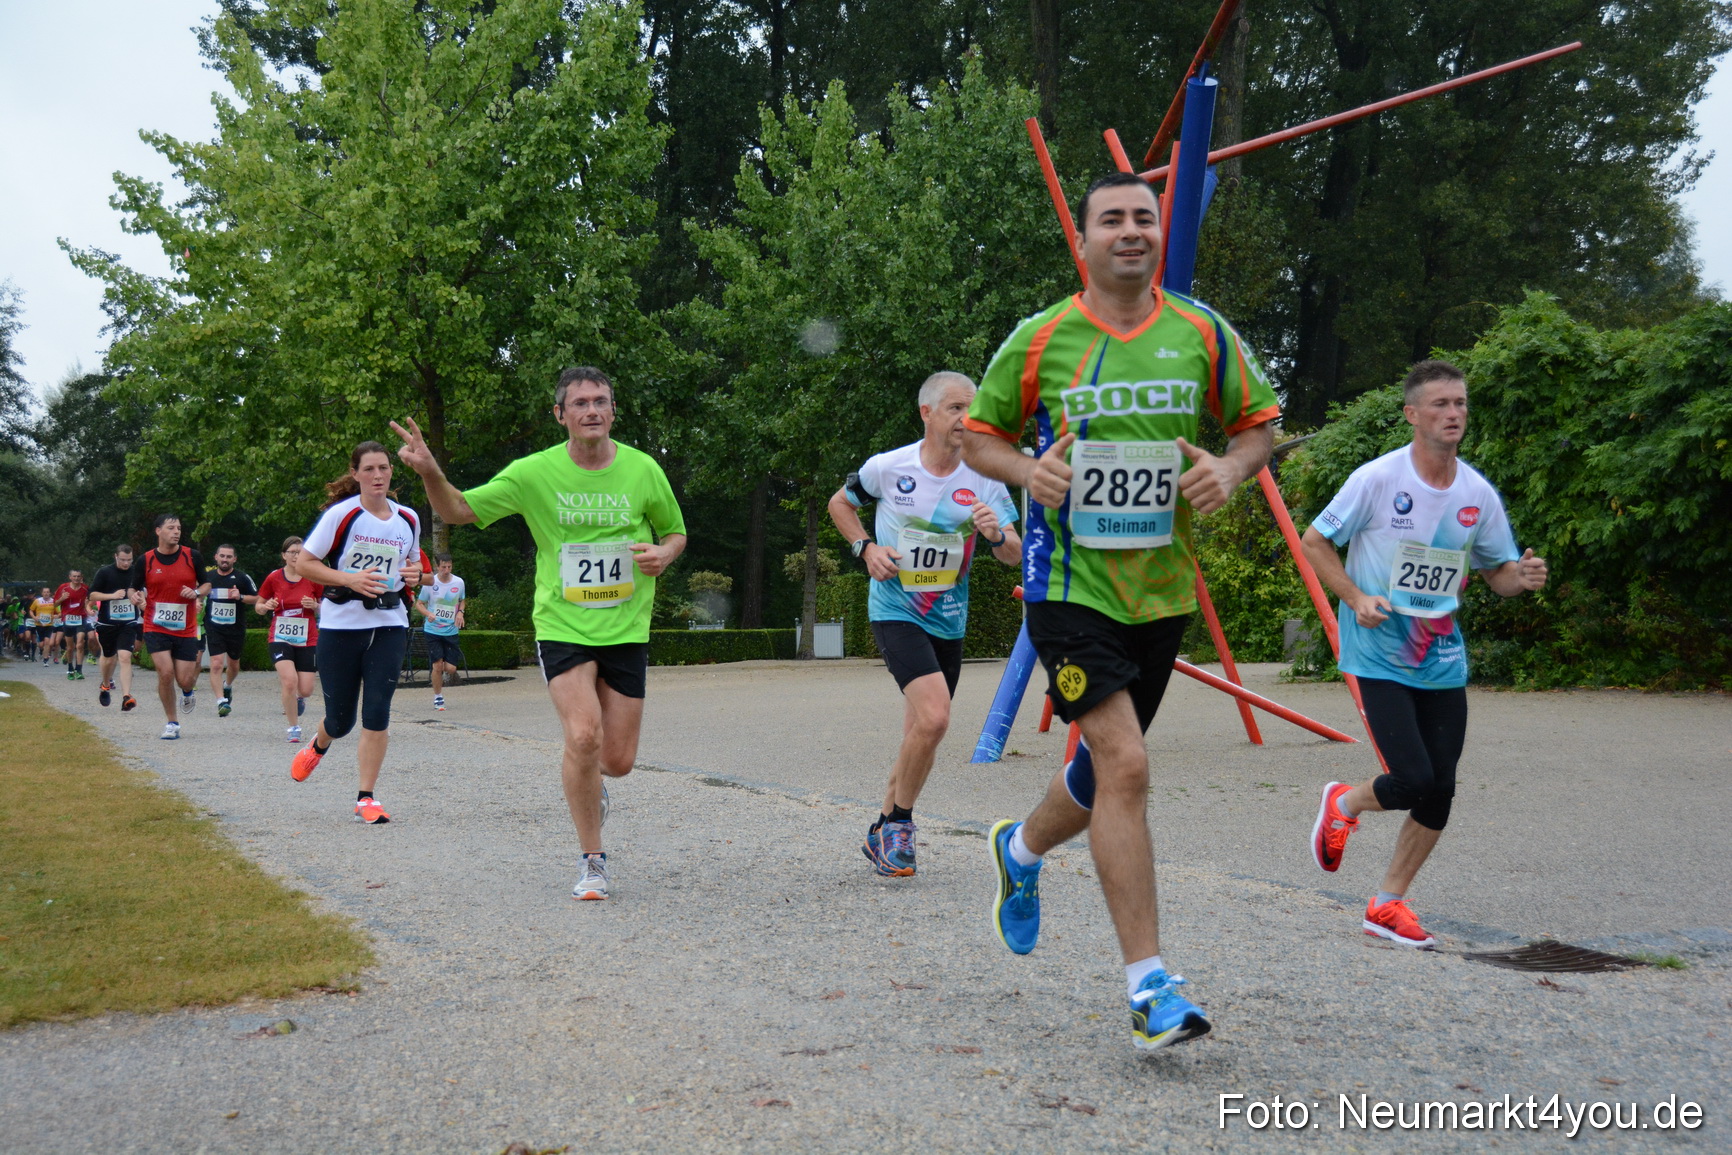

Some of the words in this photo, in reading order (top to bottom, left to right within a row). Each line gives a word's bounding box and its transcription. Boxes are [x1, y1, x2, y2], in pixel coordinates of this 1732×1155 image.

[1060, 379, 1198, 422] BOCK
[1124, 446, 1174, 459] BOCK
[1082, 467, 1173, 507] 2825
[556, 491, 631, 508] NOVINA
[894, 495, 915, 503] PARTL
[558, 510, 631, 527] HOTELS
[1096, 517, 1157, 533] Sleiman
[1391, 516, 1415, 526] PARTL
[354, 534, 404, 549] SPARKASSEN
[910, 546, 948, 569] 101
[1429, 550, 1460, 561] BOCK
[351, 552, 393, 575] 2221
[578, 558, 621, 584] 214
[1397, 561, 1458, 593] 2587
[914, 574, 938, 584] Claus
[582, 589, 619, 600] Thomas
[1410, 595, 1435, 608] Viktor
[113, 604, 132, 614] 2851
[158, 609, 184, 622] 2882
[214, 607, 234, 617] 2478
[435, 608, 454, 619] 2067
[279, 623, 305, 636] 2581
